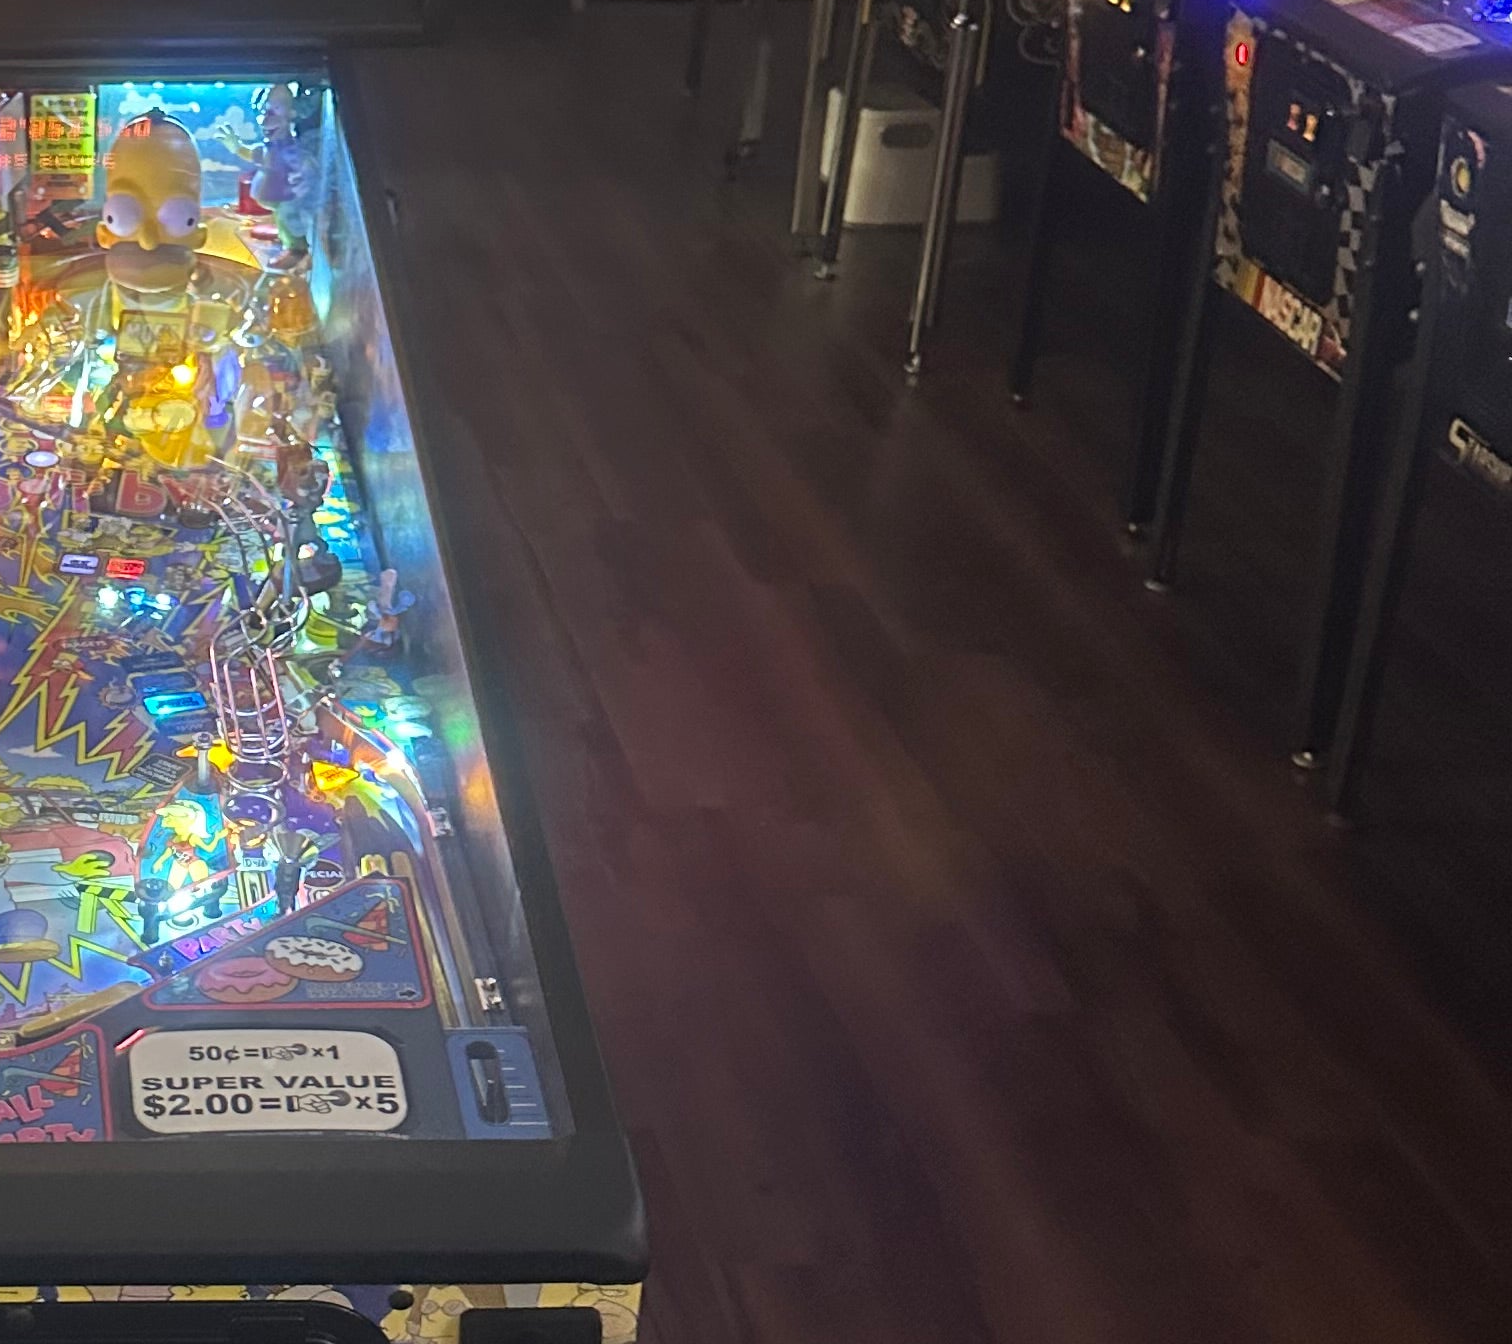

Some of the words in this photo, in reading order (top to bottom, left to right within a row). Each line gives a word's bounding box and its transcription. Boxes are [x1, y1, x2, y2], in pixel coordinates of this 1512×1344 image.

[1258, 275, 1324, 356] NASCAR
[172, 916, 263, 962] PARTY
[141, 1076, 265, 1091] SUPER
[274, 1075, 397, 1089] VALUE
